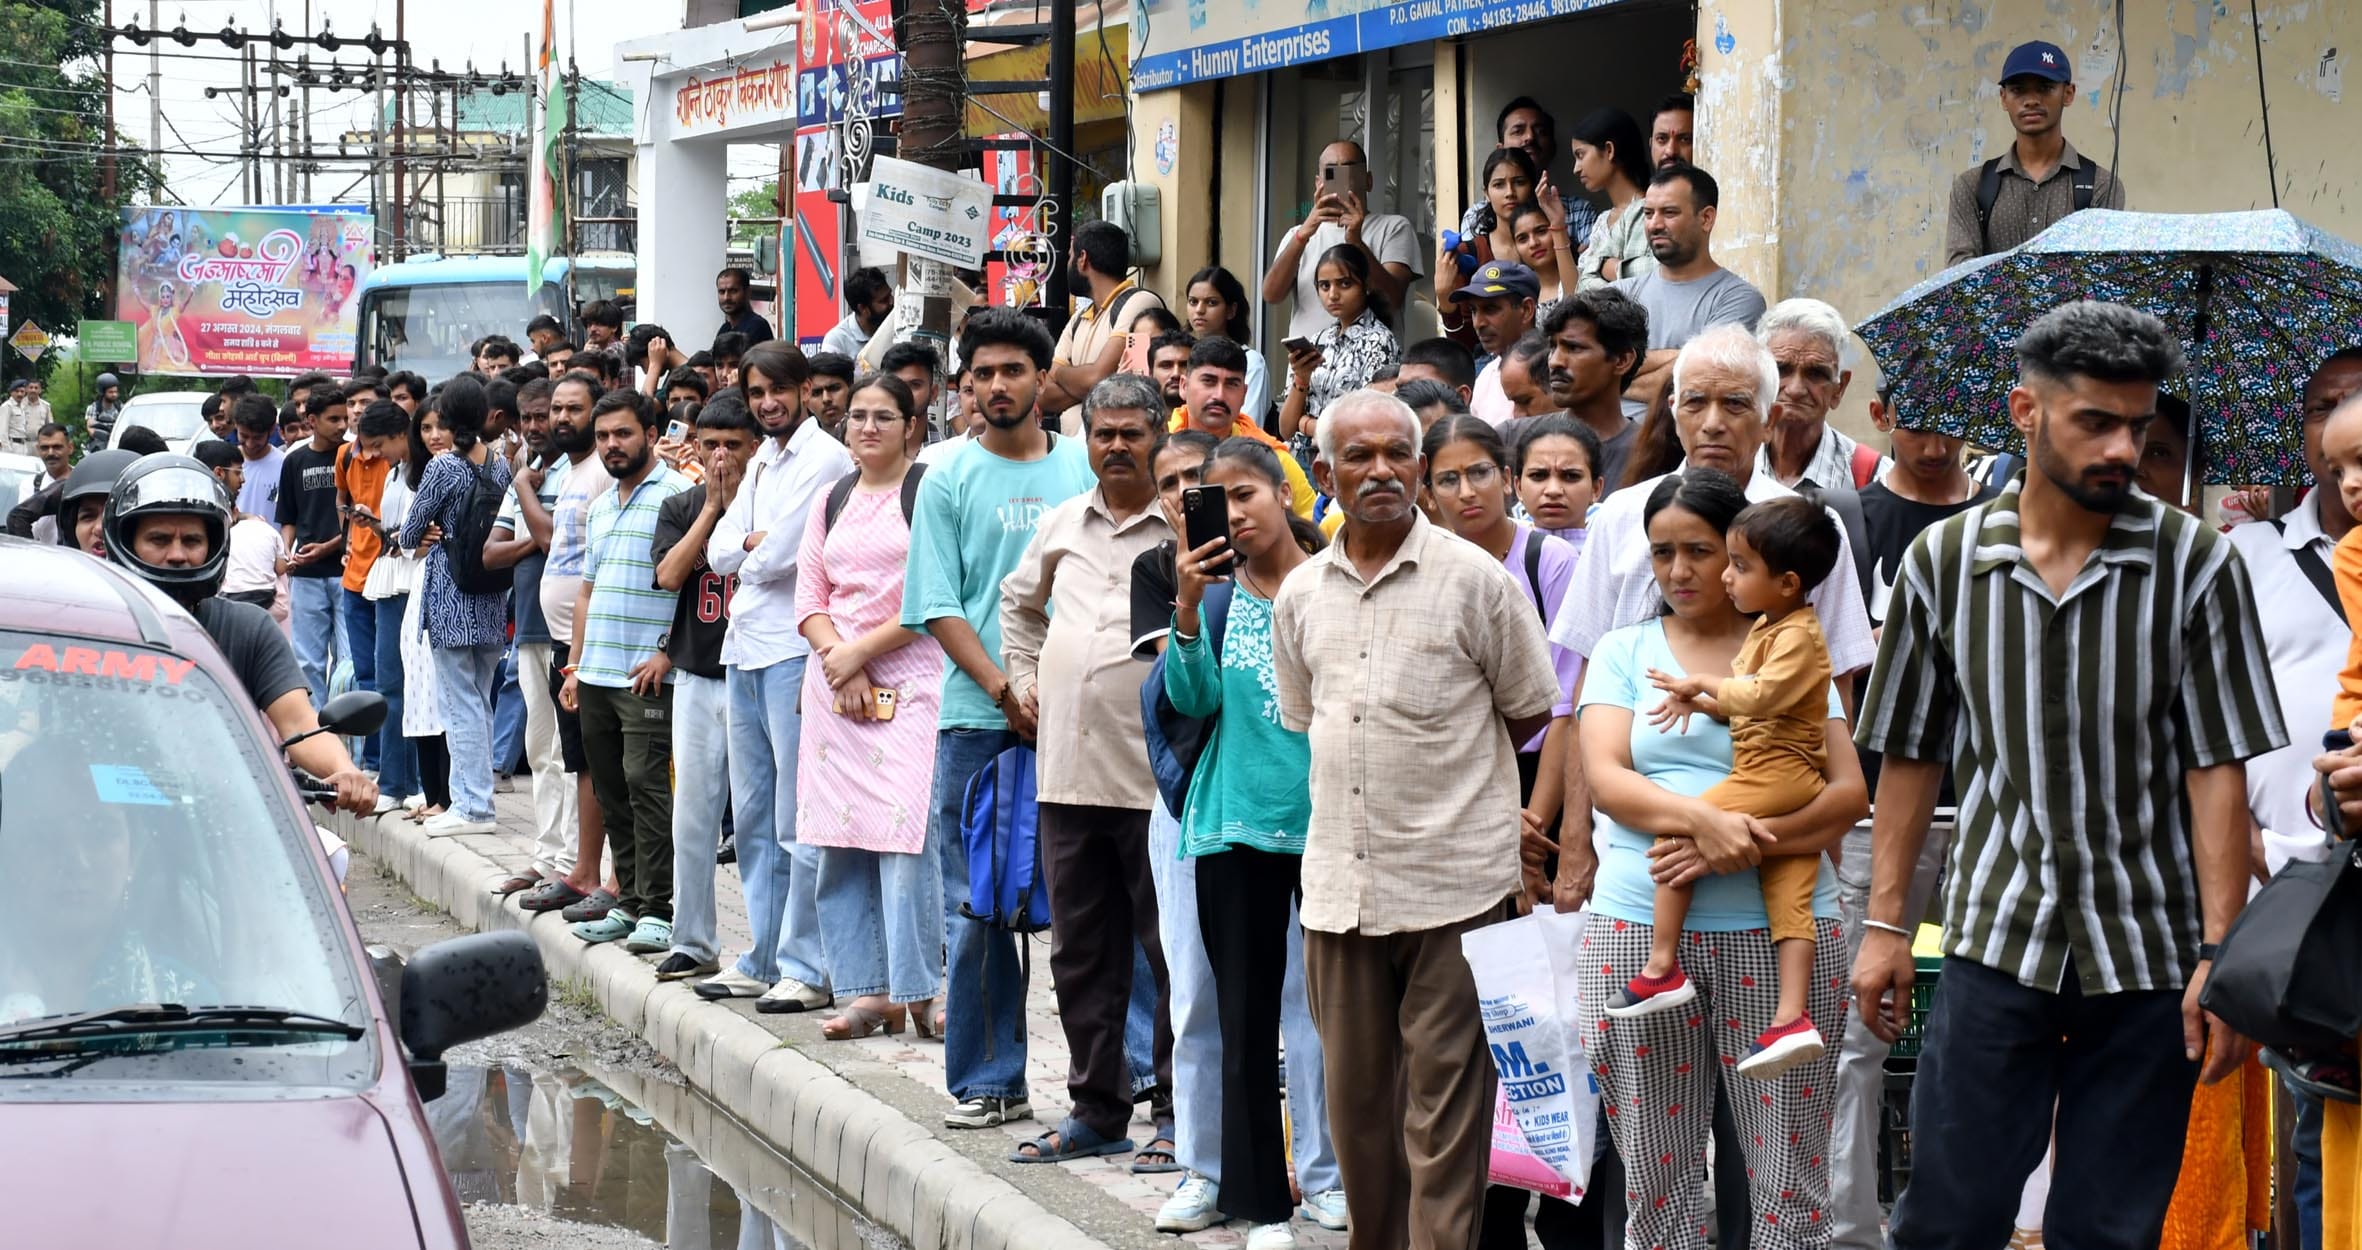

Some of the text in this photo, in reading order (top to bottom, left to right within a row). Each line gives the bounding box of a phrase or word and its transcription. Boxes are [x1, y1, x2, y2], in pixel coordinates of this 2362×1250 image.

[1389, 7, 1408, 25] P.O.
[1409, 0, 1443, 21] GAWAL
[1447, 16, 1471, 36] CON.
[1192, 47, 1239, 79] Hunny
[1243, 26, 1330, 68] Enterprises
[703, 76, 735, 126] ठाकुर
[875, 183, 915, 206] Kids
[907, 220, 942, 241] Camp
[944, 231, 972, 248] 2023
[222, 281, 299, 316] महोत्सव
[200, 323, 211, 332] 27
[212, 323, 238, 334] अगस्त
[303, 474, 336, 491] EAGL
[15, 643, 196, 686] ARMY
[1533, 1111, 1569, 1127] KIDS WEAR
